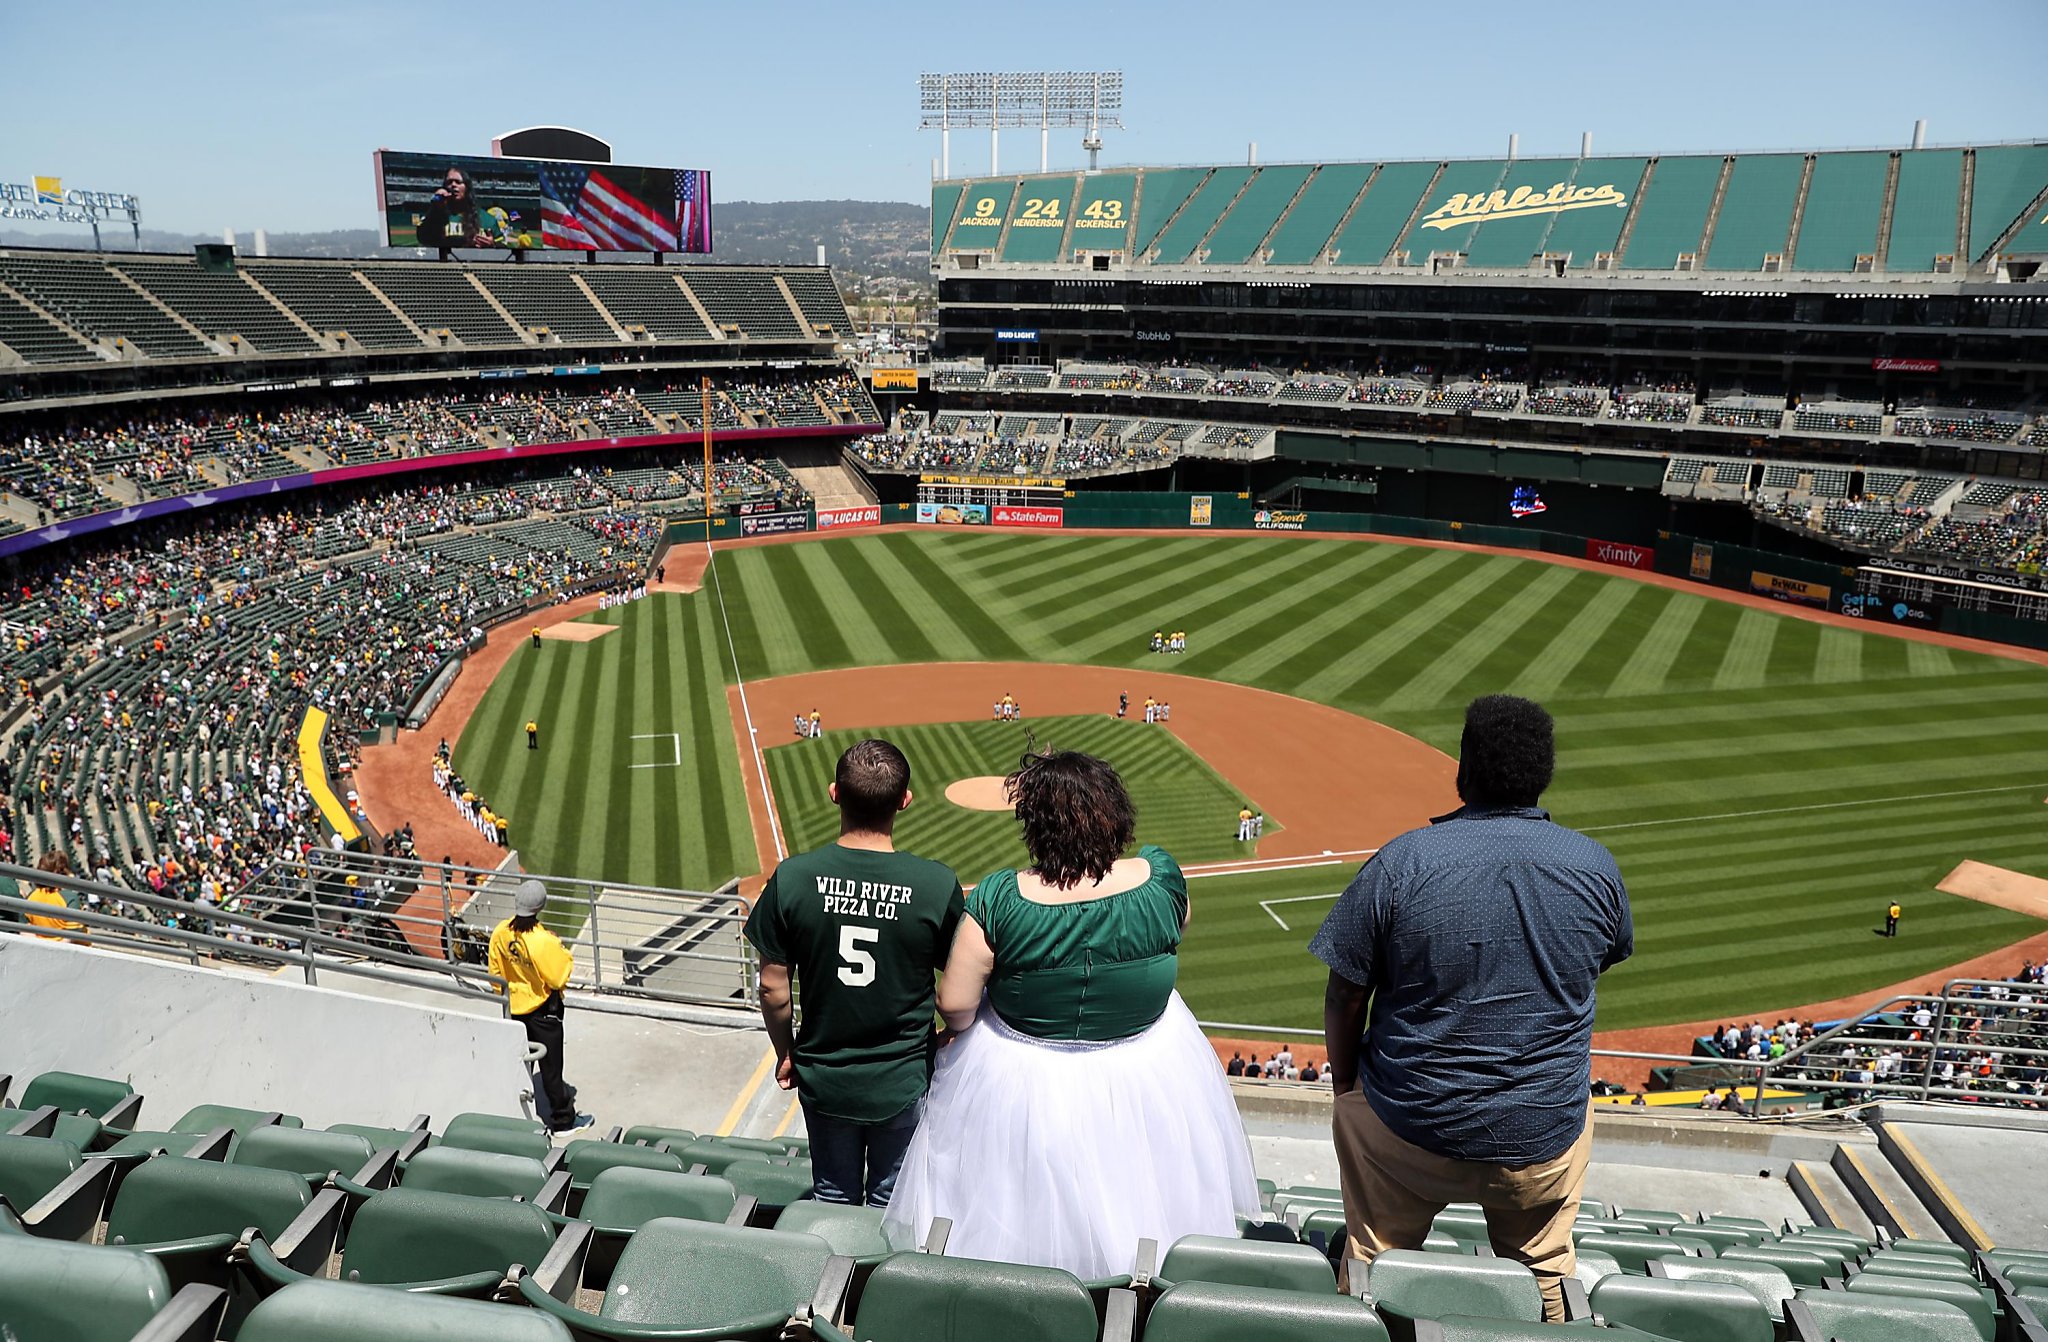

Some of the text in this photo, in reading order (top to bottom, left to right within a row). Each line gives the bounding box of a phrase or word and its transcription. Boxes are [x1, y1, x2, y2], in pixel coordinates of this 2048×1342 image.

[975, 198, 996, 217] 9
[1022, 199, 1060, 219] 24
[1084, 200, 1122, 220] 43
[1422, 183, 1625, 225] Athletics
[959, 217, 1001, 227] JACKSON
[1012, 218, 1064, 228] HENDERSON
[1075, 219, 1127, 229] ECKERSLEY
[1136, 331, 1171, 341] StubHub
[1876, 359, 1937, 371] Budweiser
[786, 515, 807, 525] xfinity
[833, 510, 878, 524] LUCAS OIL
[1270, 510, 1308, 523] Sports
[1255, 522, 1303, 530] CALIFORNIA
[1598, 545, 1642, 566] xfinity
[1868, 558, 1967, 579] ORACLE NETSUITE
[1975, 573, 2028, 587] ORACLE
[1842, 592, 1882, 606] Get in.
[1841, 604, 1864, 617] Go!
[1908, 609, 1925, 619] GIG
[815, 876, 912, 904] WILD RIVER
[823, 895, 899, 921] PIZZA CO.
[837, 925, 879, 987] 5
